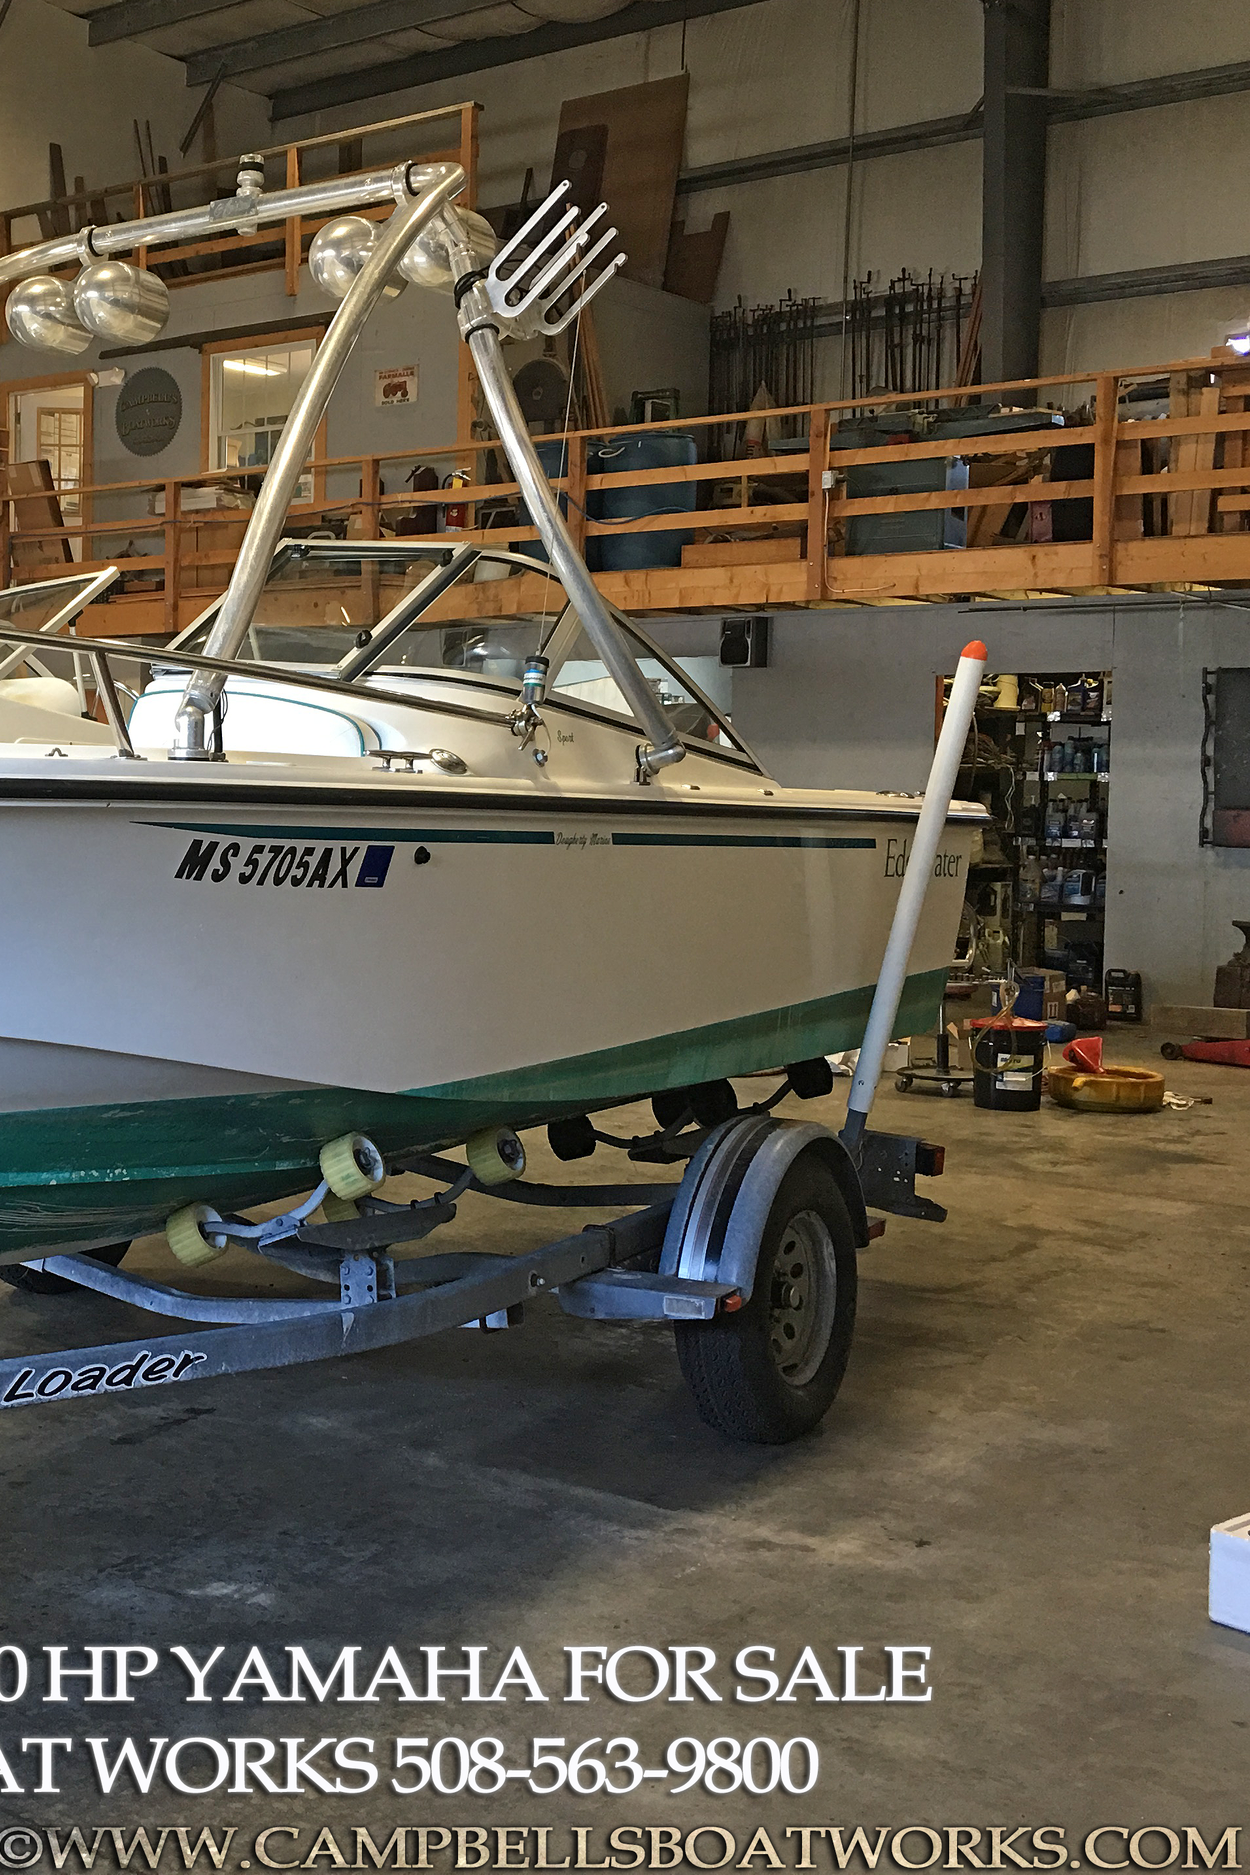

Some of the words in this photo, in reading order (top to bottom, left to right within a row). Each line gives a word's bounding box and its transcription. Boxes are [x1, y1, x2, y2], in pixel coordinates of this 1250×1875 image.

[174, 839, 241, 883] MS
[238, 844, 361, 889] 5705AX
[883, 838, 963, 878] Edater
[0, 1350, 208, 1405] Loader
